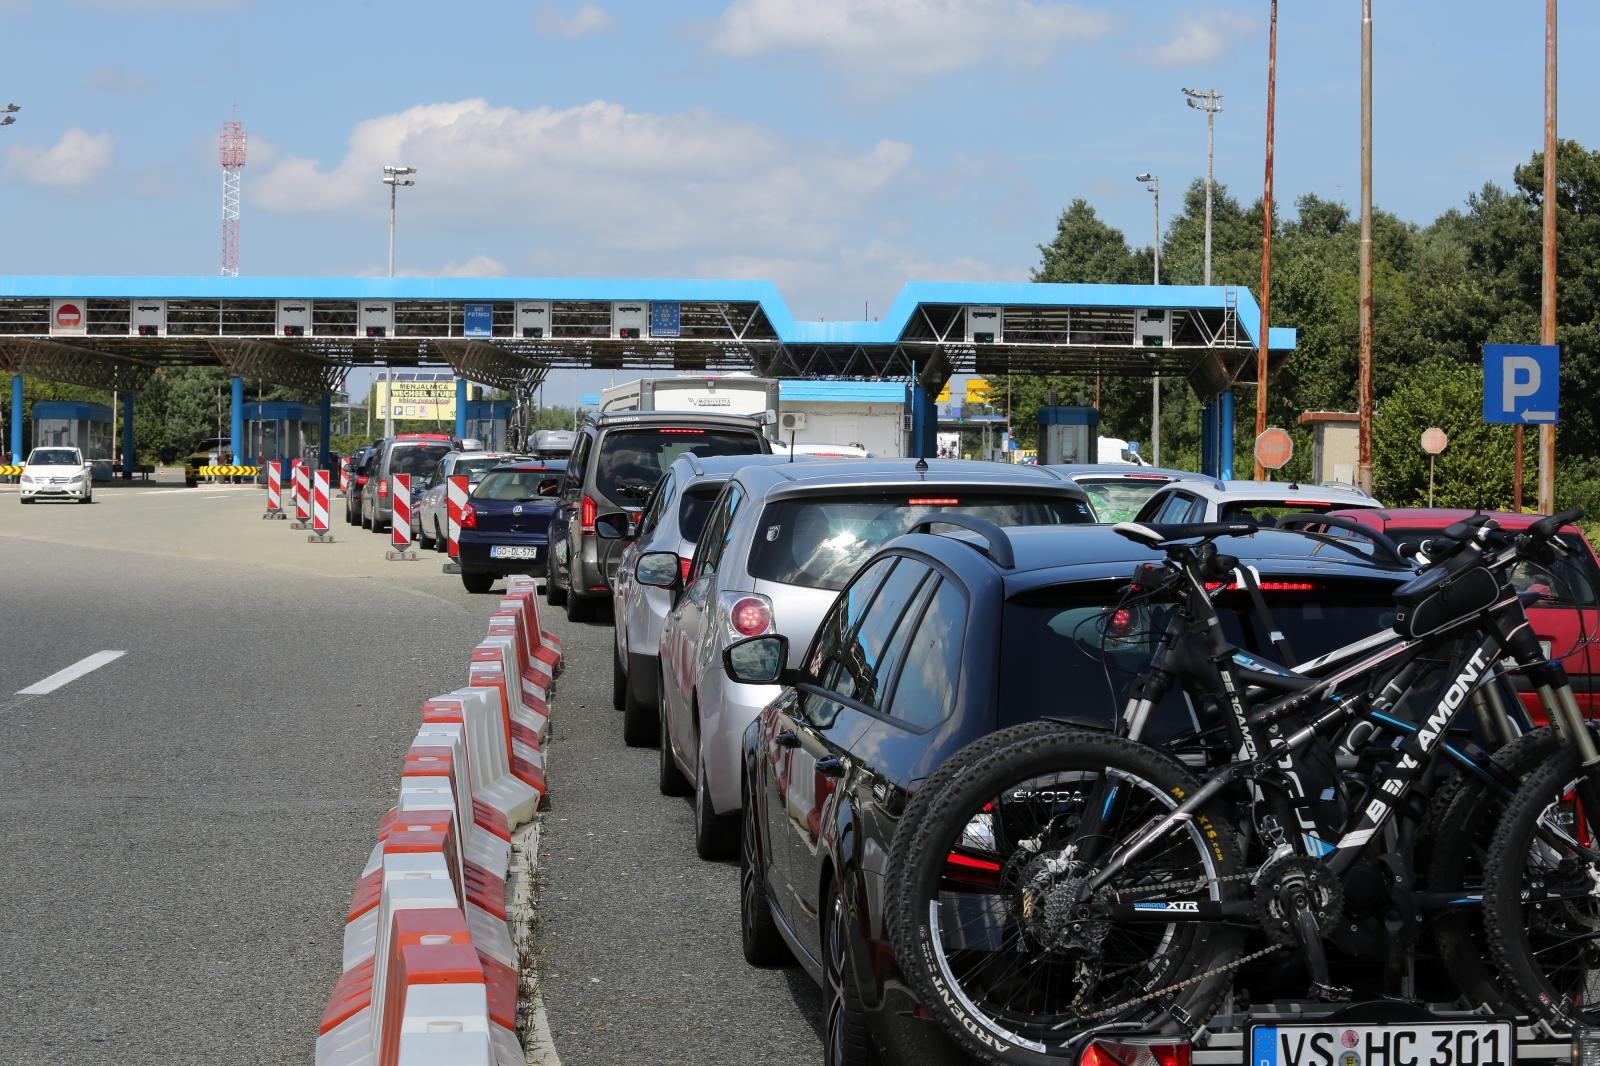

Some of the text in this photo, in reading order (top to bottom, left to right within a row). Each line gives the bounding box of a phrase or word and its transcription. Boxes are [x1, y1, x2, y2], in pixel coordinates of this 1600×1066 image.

[1503, 356, 1541, 412] P
[1013, 789, 1085, 803] ŠKODA
[1167, 901, 1198, 909] XTR
[931, 975, 1011, 1052] ARDENT
[1281, 1032, 1335, 1066] VS
[1365, 1031, 1418, 1066] HC
[1430, 1029, 1506, 1066] 301
